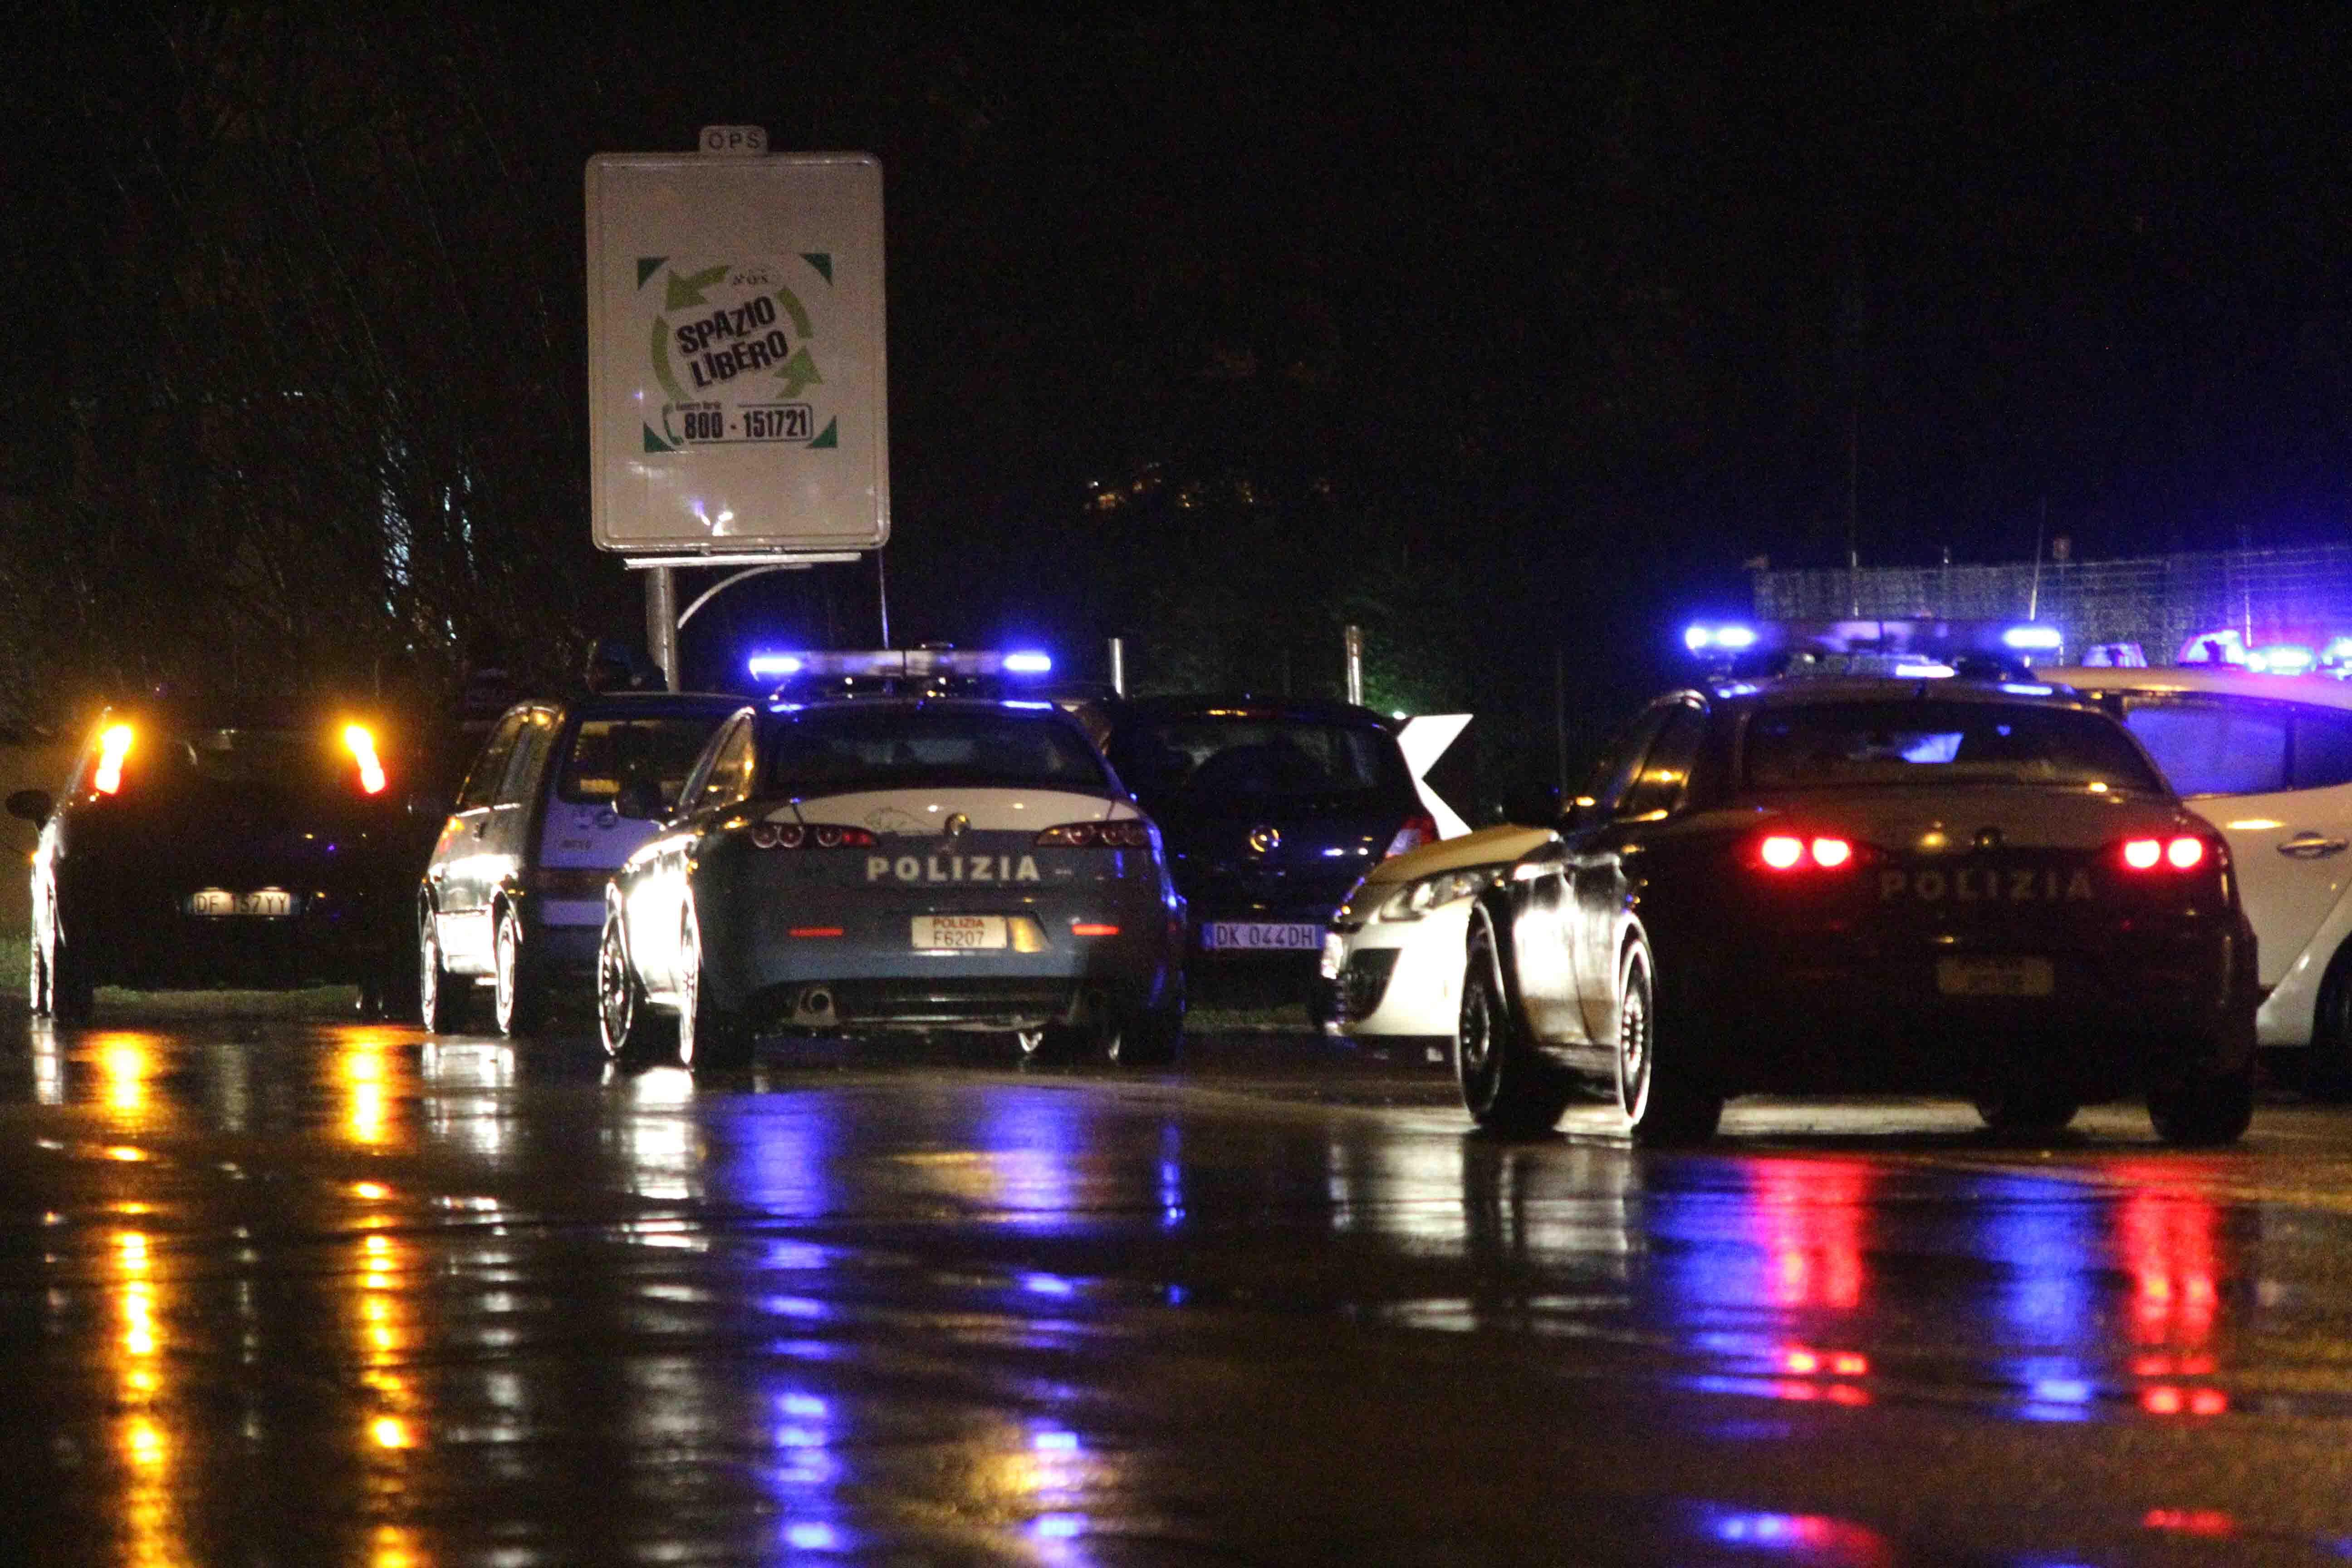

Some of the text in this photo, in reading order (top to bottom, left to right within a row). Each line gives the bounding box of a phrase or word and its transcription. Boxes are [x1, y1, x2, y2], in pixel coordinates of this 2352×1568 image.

[709, 132, 760, 149] OPS
[676, 296, 775, 353] SPAZIO
[690, 330, 789, 387] LIBERO
[685, 412, 723, 439] 800
[743, 409, 807, 437] 151721
[867, 856, 1041, 882] POLIZIA
[1879, 870, 2094, 901] POLIZIA
[932, 918, 985, 928] POLIZIA
[1216, 926, 1313, 946] DK 044DH
[933, 931, 984, 946] F6207
